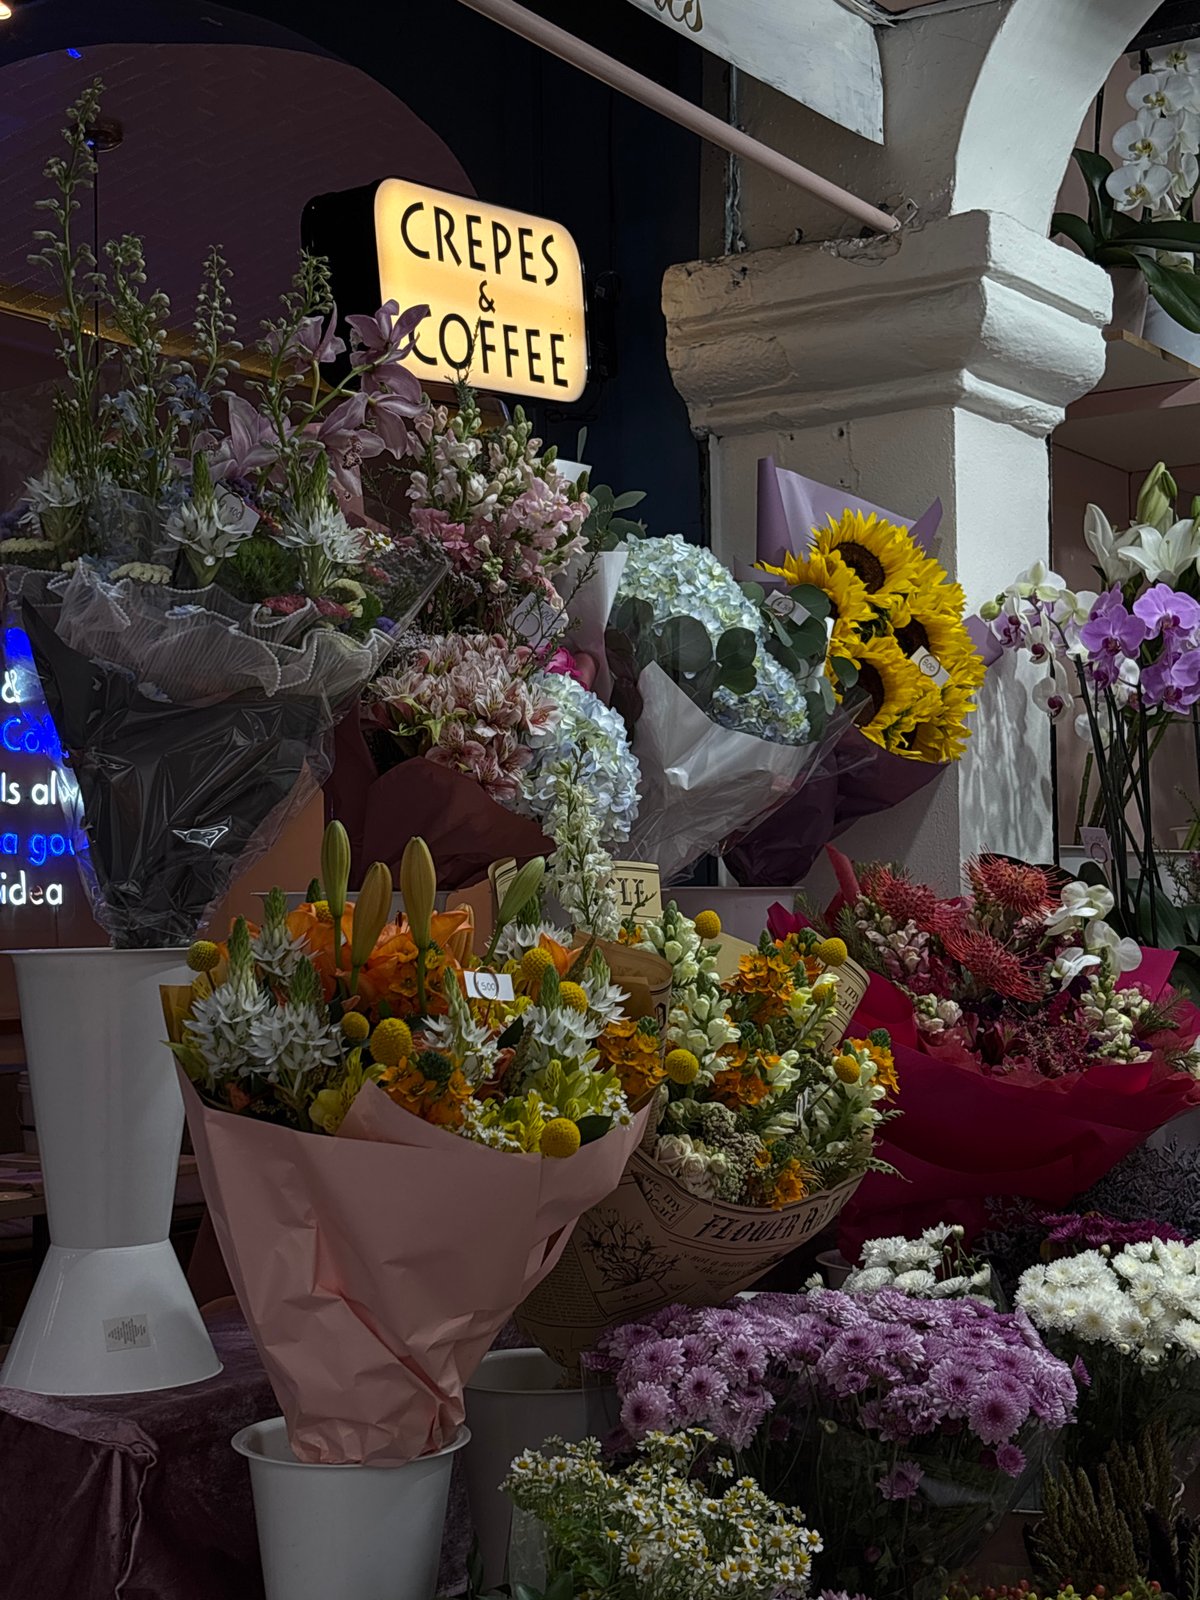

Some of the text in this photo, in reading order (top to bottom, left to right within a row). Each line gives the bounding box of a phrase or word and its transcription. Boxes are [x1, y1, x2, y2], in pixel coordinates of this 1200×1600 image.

[400, 202, 559, 286] CREPES
[478, 279, 496, 313] &
[408, 304, 569, 388] COFFEE
[1, 669, 23, 703] &
[0, 870, 63, 905] idea
[644, 1188, 676, 1221] heart
[663, 1194, 687, 1213] my
[694, 1213, 800, 1242] FLOWER
